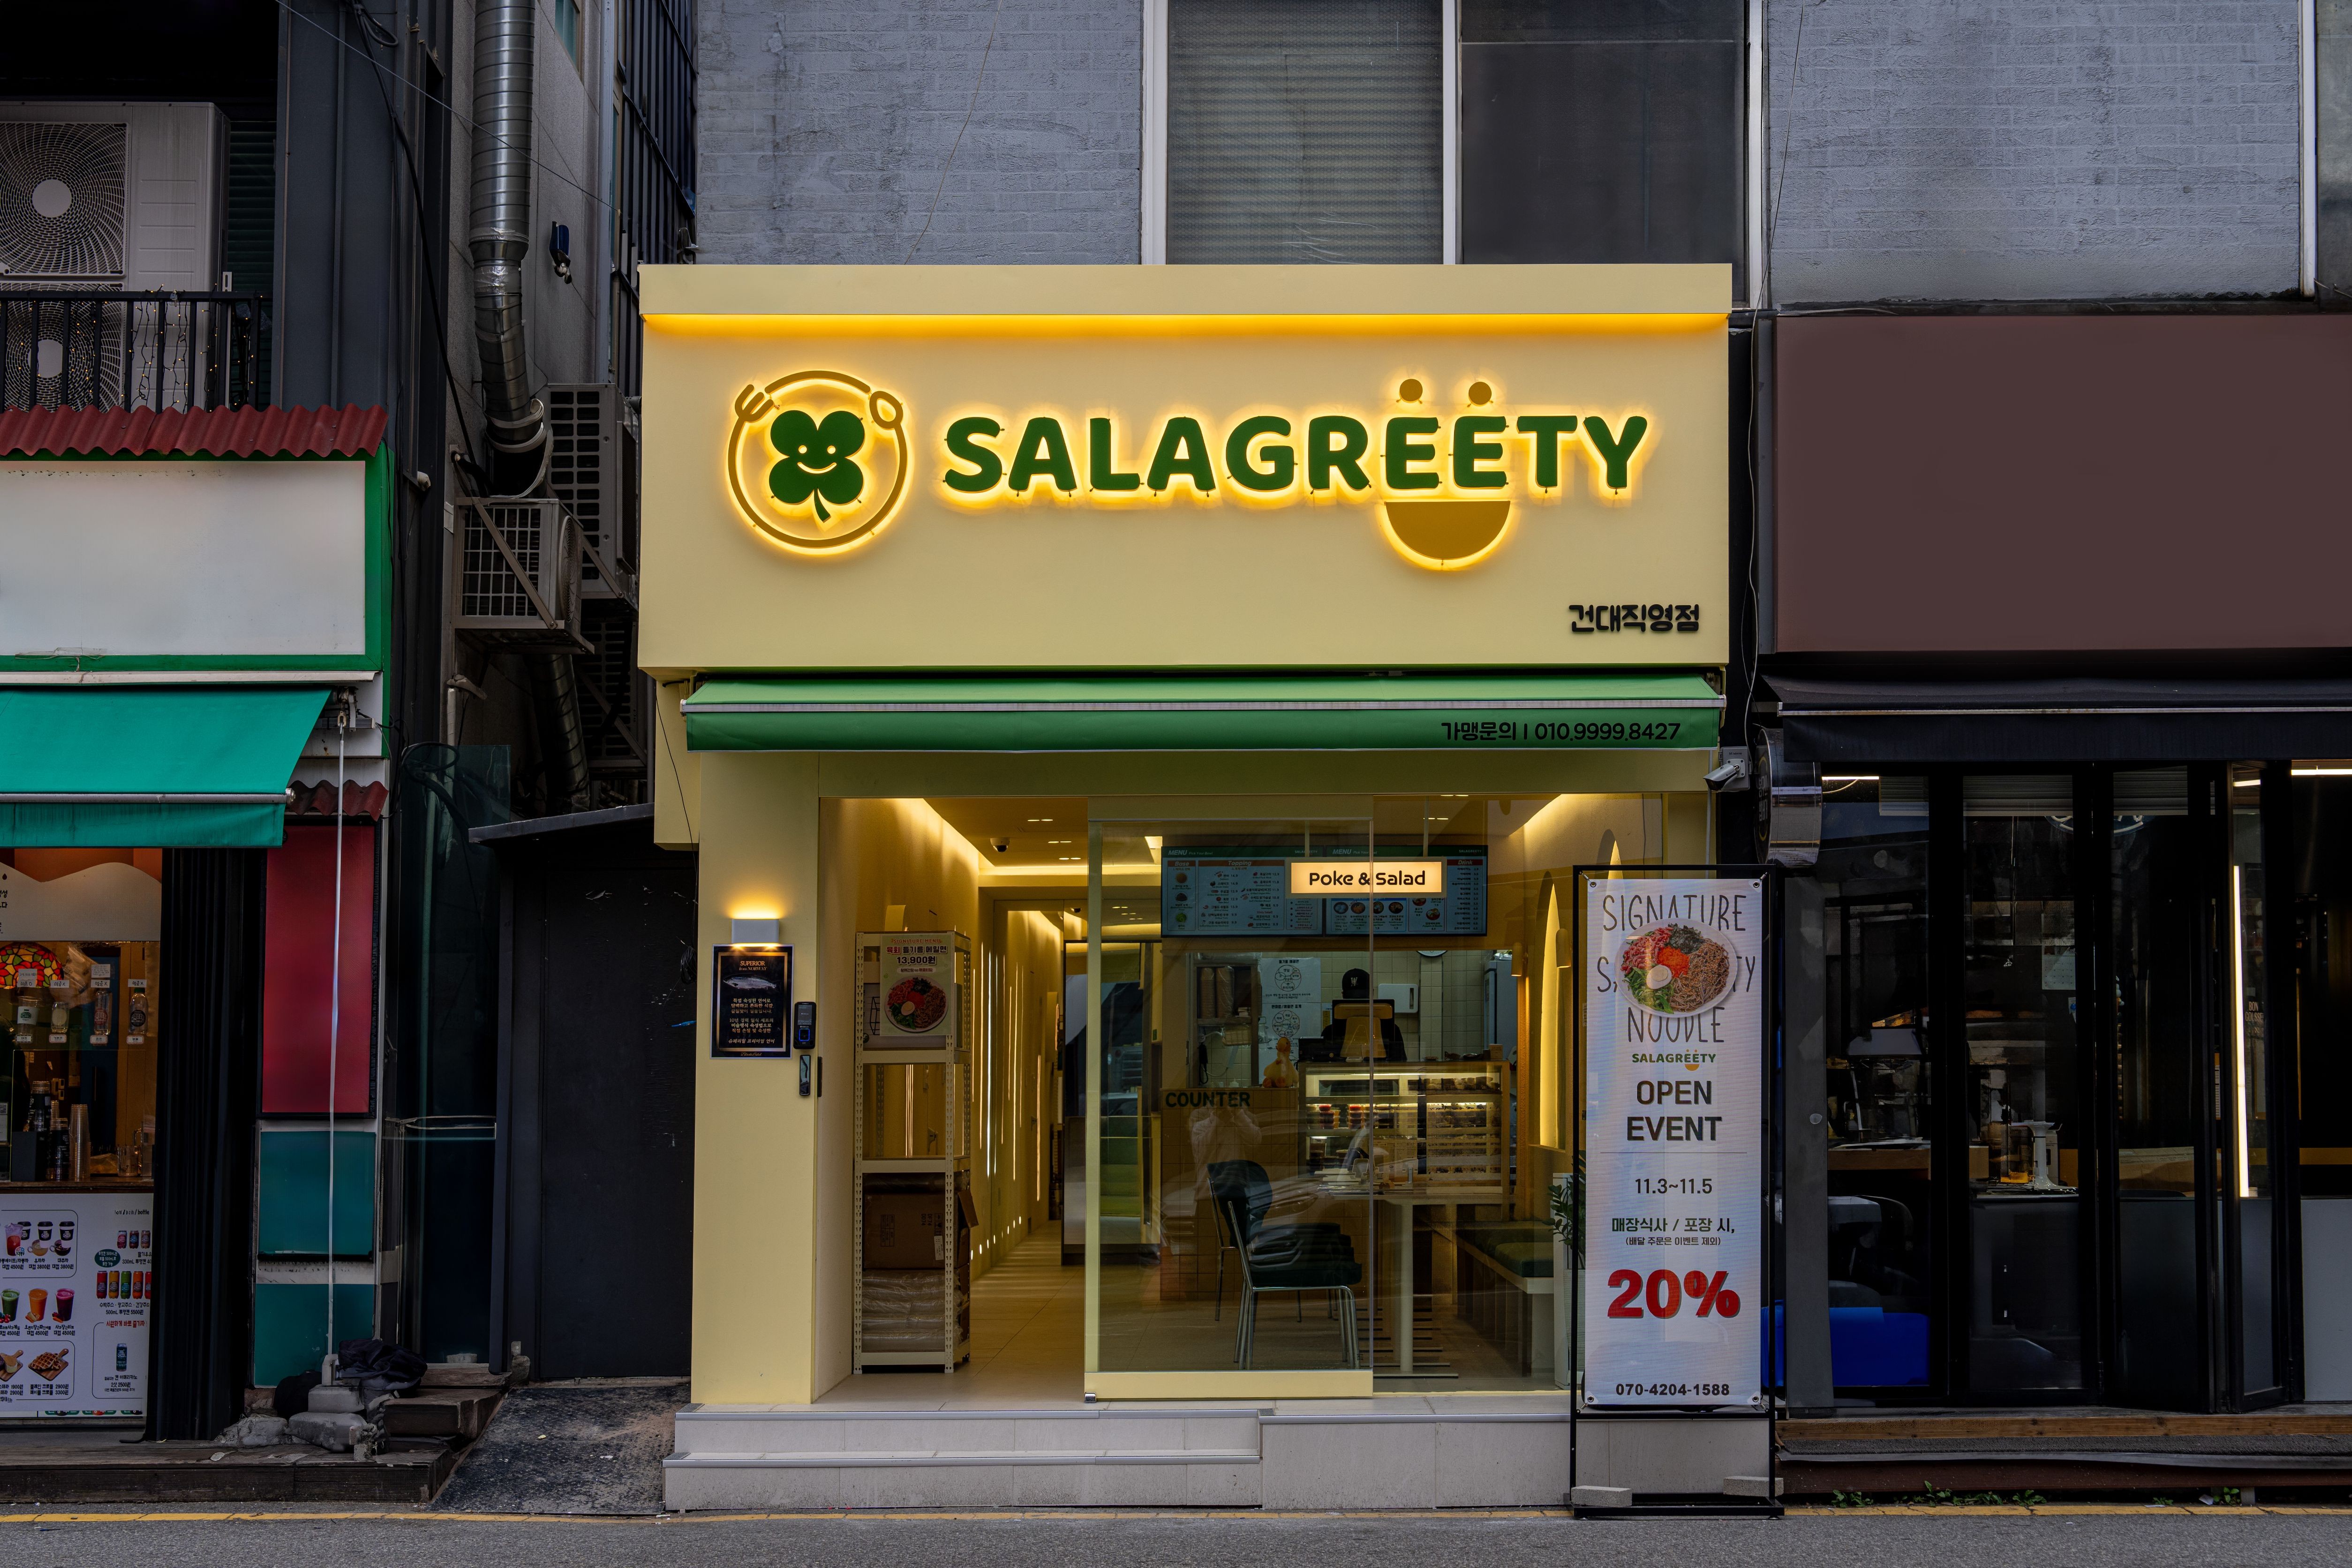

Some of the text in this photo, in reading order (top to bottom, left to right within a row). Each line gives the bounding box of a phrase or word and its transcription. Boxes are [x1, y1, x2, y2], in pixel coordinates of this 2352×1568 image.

[946, 415, 1647, 491] SALAGREETY
[1568, 603, 1700, 634] 건대직영점
[1441, 722, 1516, 740] 가맹문의
[1535, 723, 1681, 741] 010.9999.8427
[1309, 870, 1425, 886] Poke & Salad
[1603, 895, 1747, 931] SIGNATURE
[897, 956, 936, 965] 13,900원
[1628, 1007, 1725, 1043] NOODLE
[1632, 1053, 1716, 1063] SALAGREETY
[1166, 1092, 1251, 1108] COUNTER
[1636, 1080, 1712, 1105] OPEN
[1627, 1116, 1723, 1141] EVENT
[1635, 1178, 1712, 1194] 11.3~11.5
[1612, 1218, 1735, 1234] 매장식사 / 포장 시,
[1626, 1236, 1721, 1246] (배달 주문은 이벤트 제외)
[1607, 1269, 1741, 1319] 20%
[1616, 1383, 1730, 1396] 070-4204-1588
